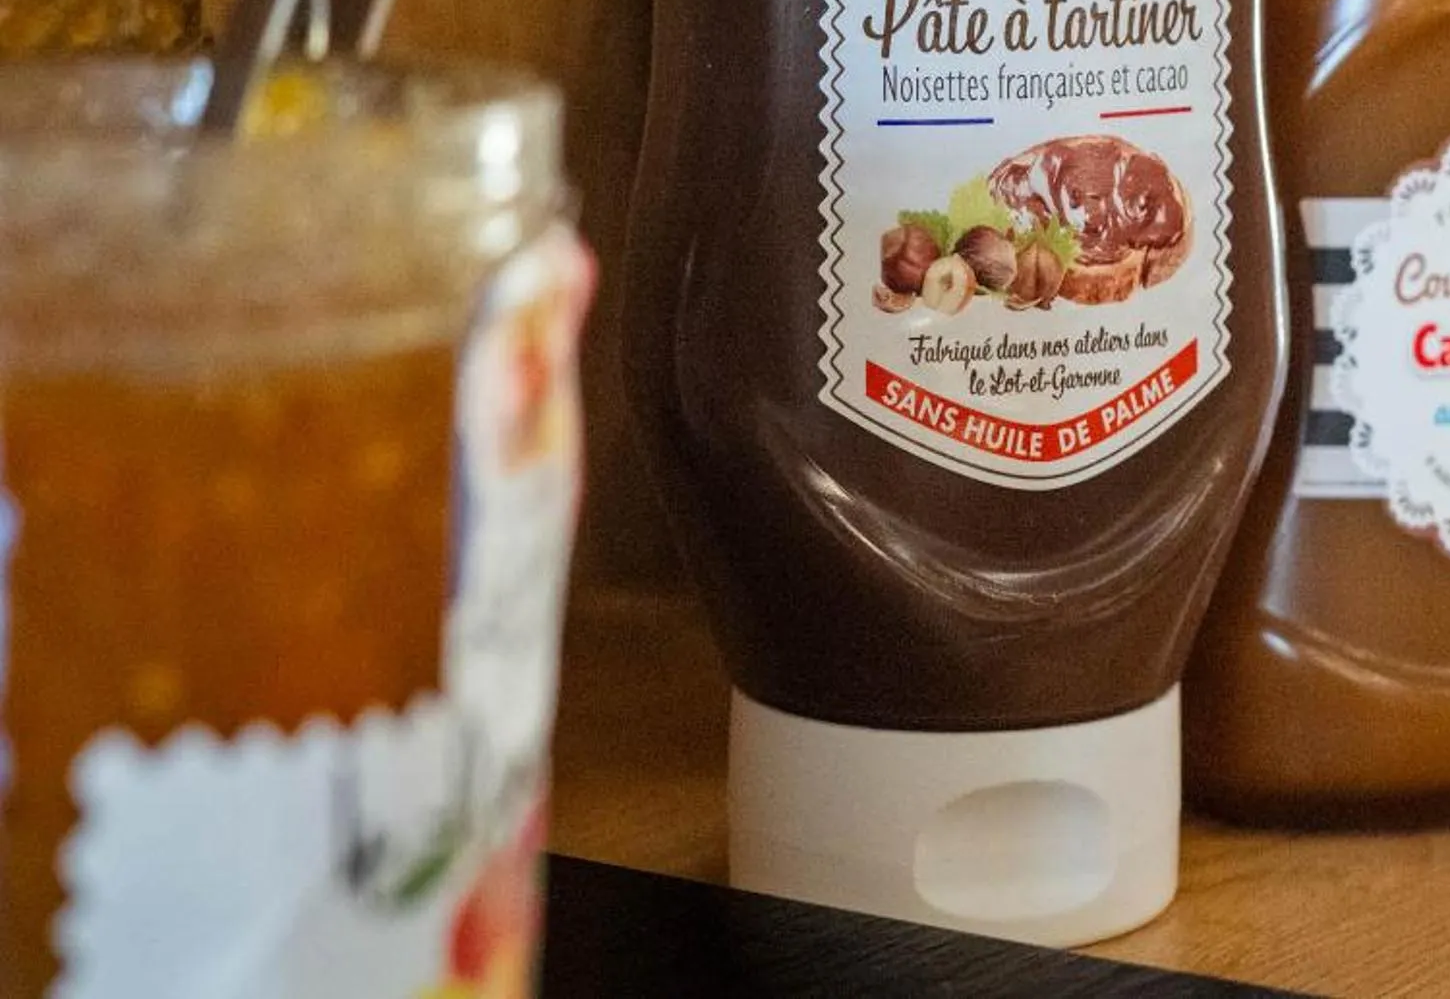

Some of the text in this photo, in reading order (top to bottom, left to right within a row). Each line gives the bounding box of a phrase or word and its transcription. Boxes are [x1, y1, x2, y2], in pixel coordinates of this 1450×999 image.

[882, 63, 1189, 108] Noisettes françaises et cacao
[909, 322, 1169, 369] Fabriqué dans nos ateliers dans
[969, 366, 1122, 399] le Lot-et-Garonne
[881, 368, 1175, 459] SANS HUILE DE PALME
